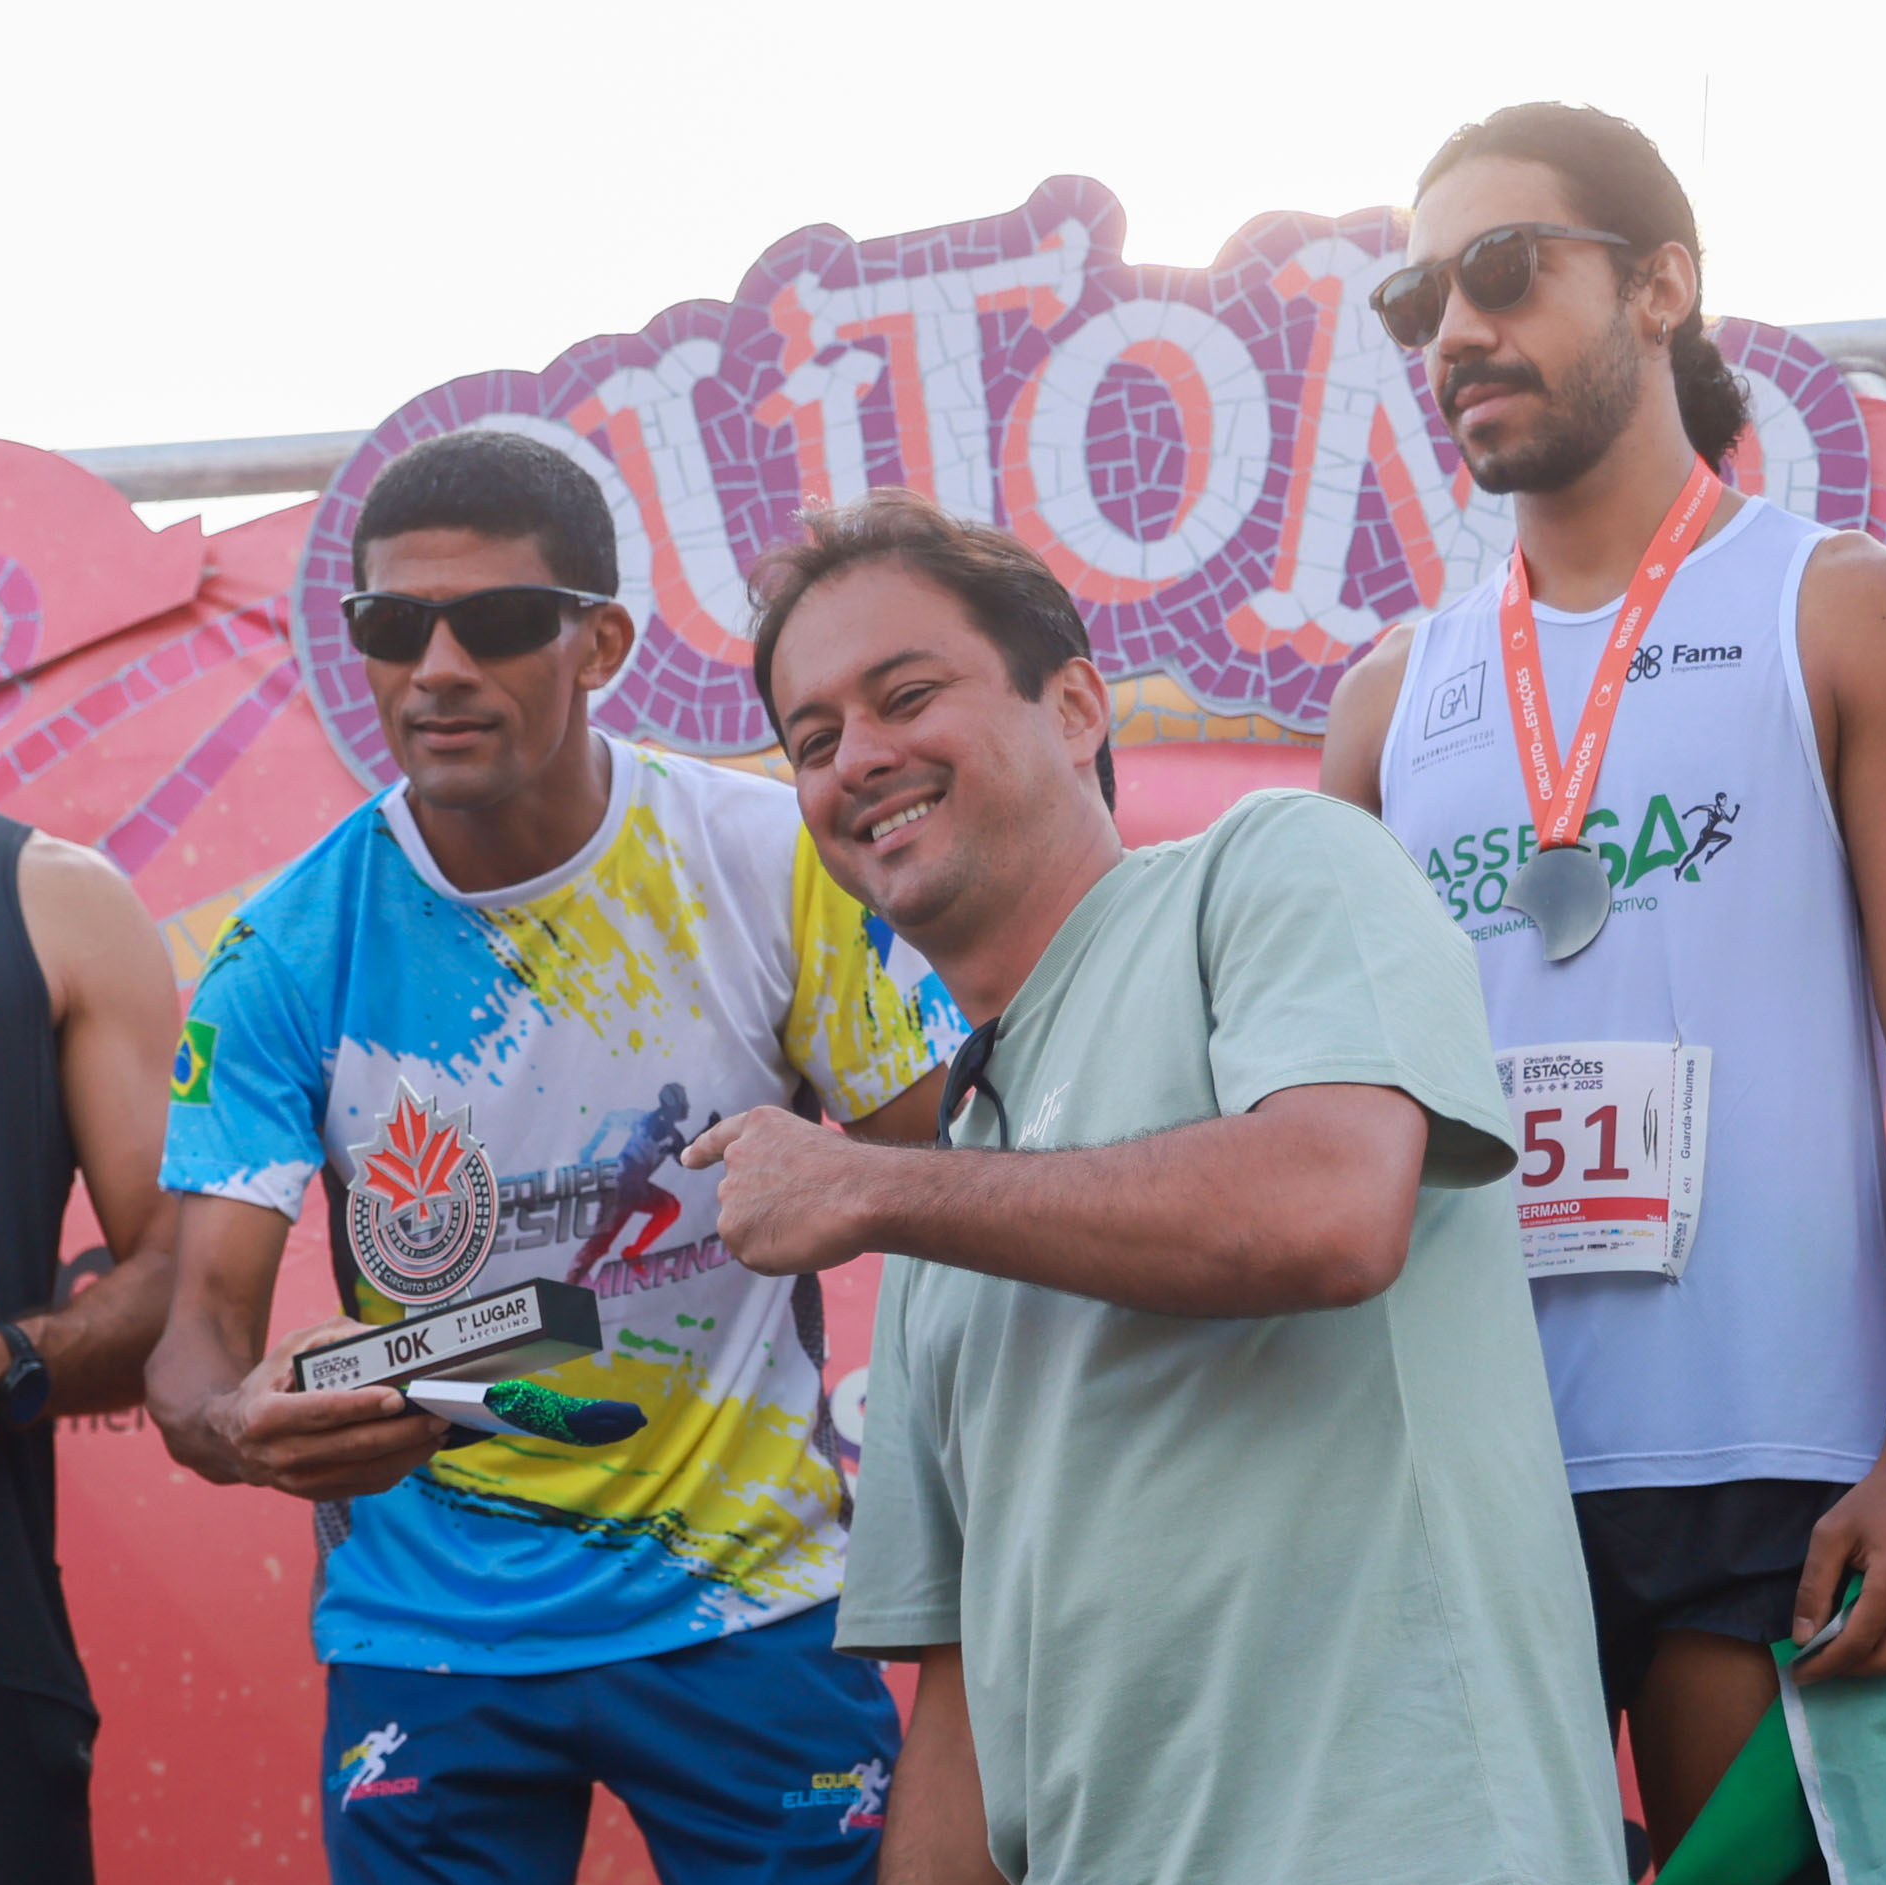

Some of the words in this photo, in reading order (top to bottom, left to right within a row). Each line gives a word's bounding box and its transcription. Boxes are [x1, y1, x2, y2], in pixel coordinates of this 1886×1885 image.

[1671, 644, 1743, 664] Fama
[1517, 667, 1538, 728] ESTAÇÕES
[1530, 742, 1554, 801] CIRCUITO
[1565, 731, 1596, 800] ESTAÇÕES
[1522, 1060, 1604, 1081] ESTAÇÕES
[1573, 1080, 1604, 1091] 2025
[1680, 1059, 1695, 1160] Guarda-Volumes
[1522, 1105, 1629, 1187] 51
[1683, 1176, 1693, 1194] 651
[1517, 1201, 1581, 1220] GERMANO
[383, 1269, 425, 1292] CIRCUITO
[426, 1281, 445, 1292] DAS
[445, 1238, 482, 1284] ESTAÇÕES
[471, 1298, 527, 1330] LUGAR
[383, 1328, 435, 1369] 10K
